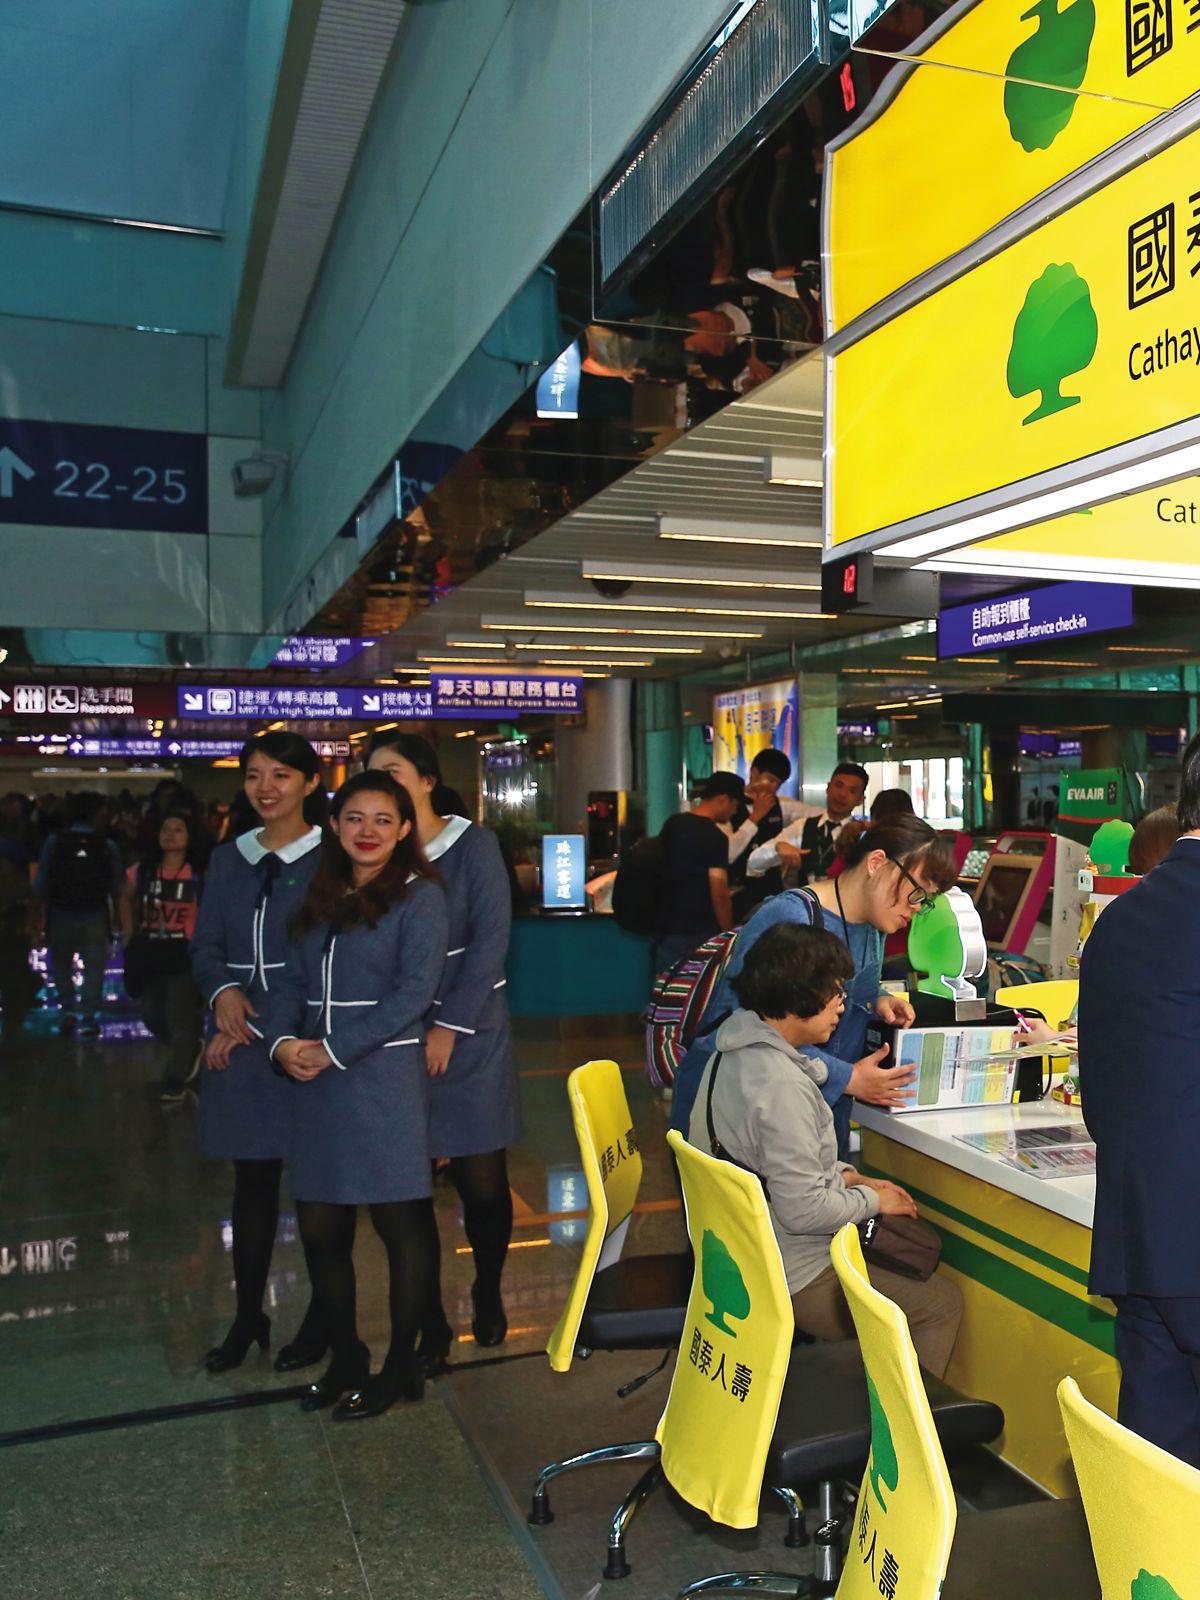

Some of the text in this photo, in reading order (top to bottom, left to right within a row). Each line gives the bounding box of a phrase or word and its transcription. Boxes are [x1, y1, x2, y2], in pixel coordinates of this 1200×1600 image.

[53, 460, 188, 504] 22-25
[972, 613, 1088, 648] Common-use self-service check-in
[80, 687, 134, 704] 洗手間
[382, 692, 432, 706] 接機大
[80, 703, 134, 715] Restroom
[281, 707, 303, 718] High
[305, 707, 334, 717] Speed
[336, 707, 352, 716] Rail
[689, 1326, 753, 1403] 國泰人壽
